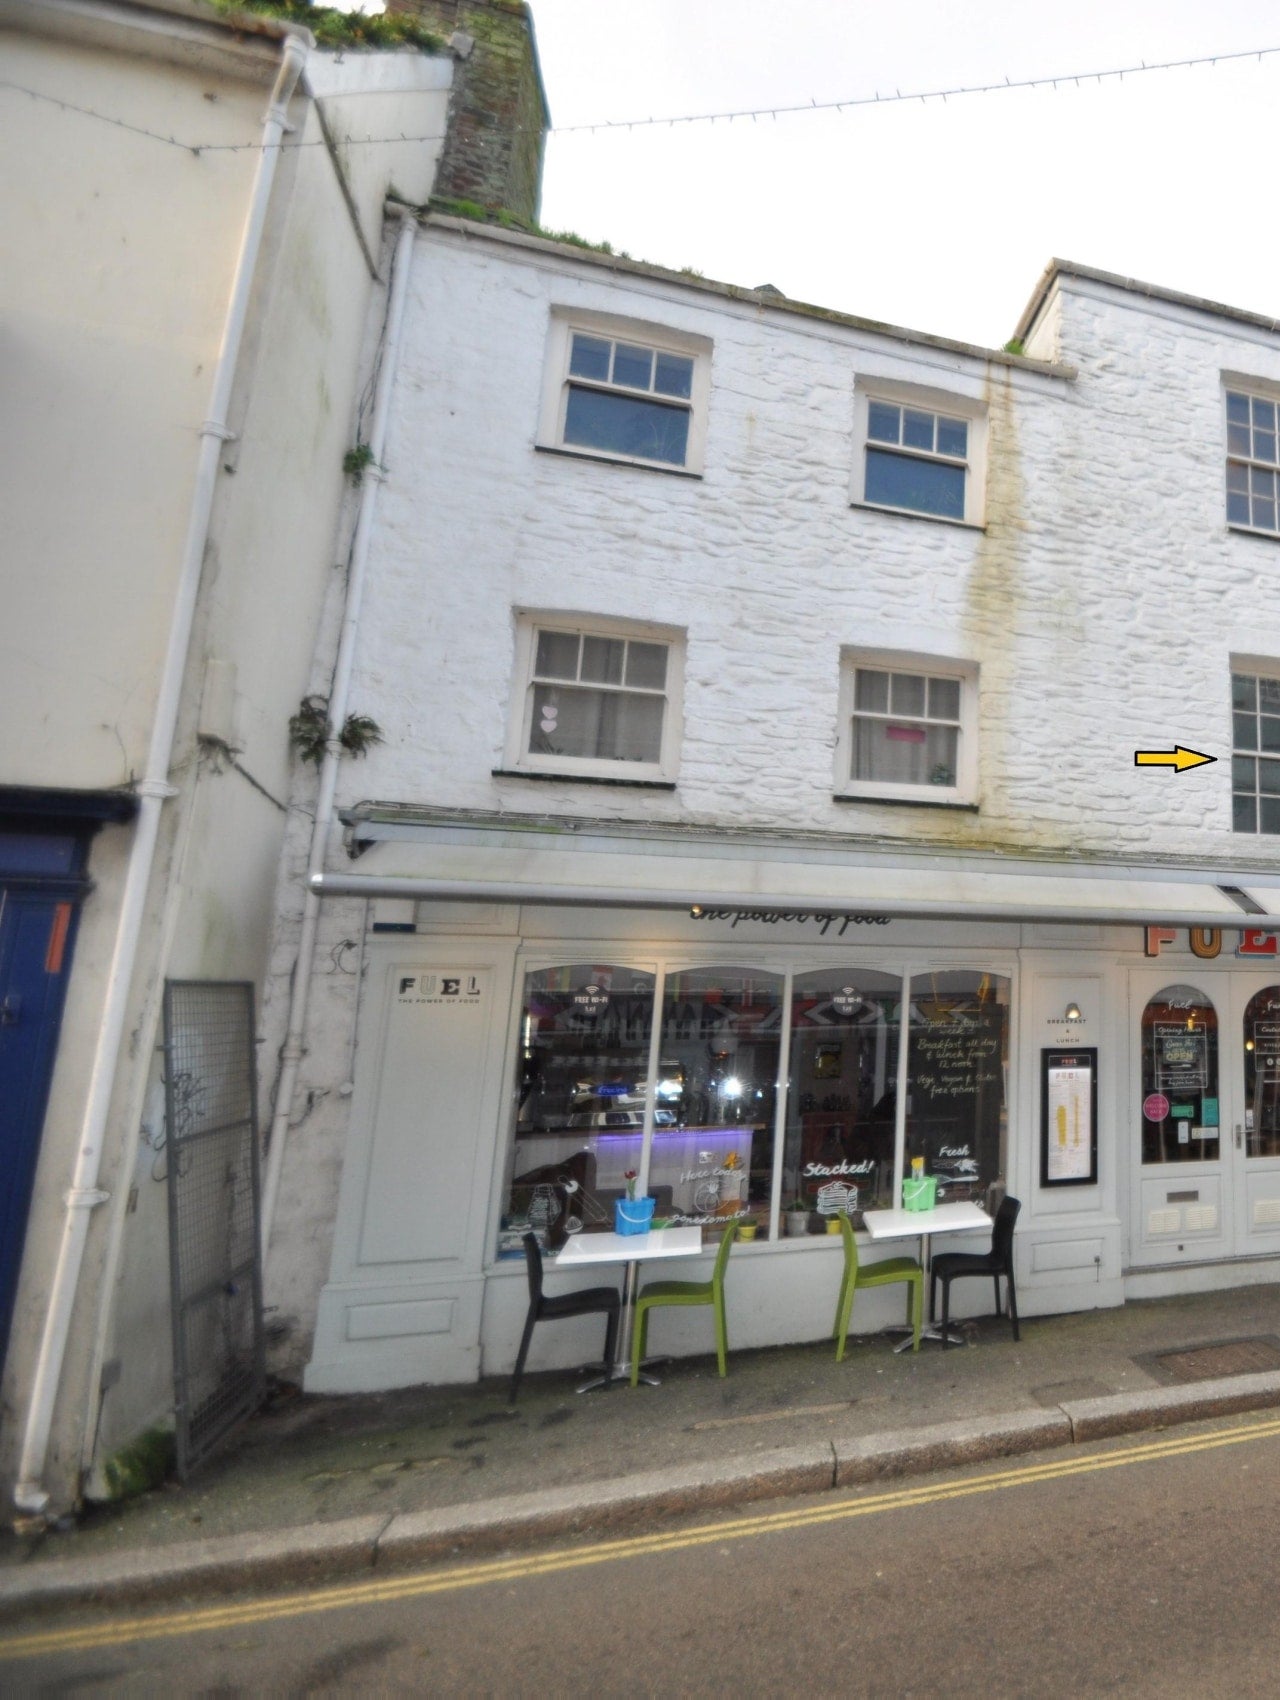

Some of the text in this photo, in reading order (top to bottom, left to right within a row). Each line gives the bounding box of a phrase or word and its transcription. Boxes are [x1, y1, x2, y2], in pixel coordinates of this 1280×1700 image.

[399, 975, 480, 995] FUEL
[1168, 998, 1193, 1011] Fuel
[938, 1144, 970, 1158] Fresh
[802, 1159, 876, 1177] Stacked!
